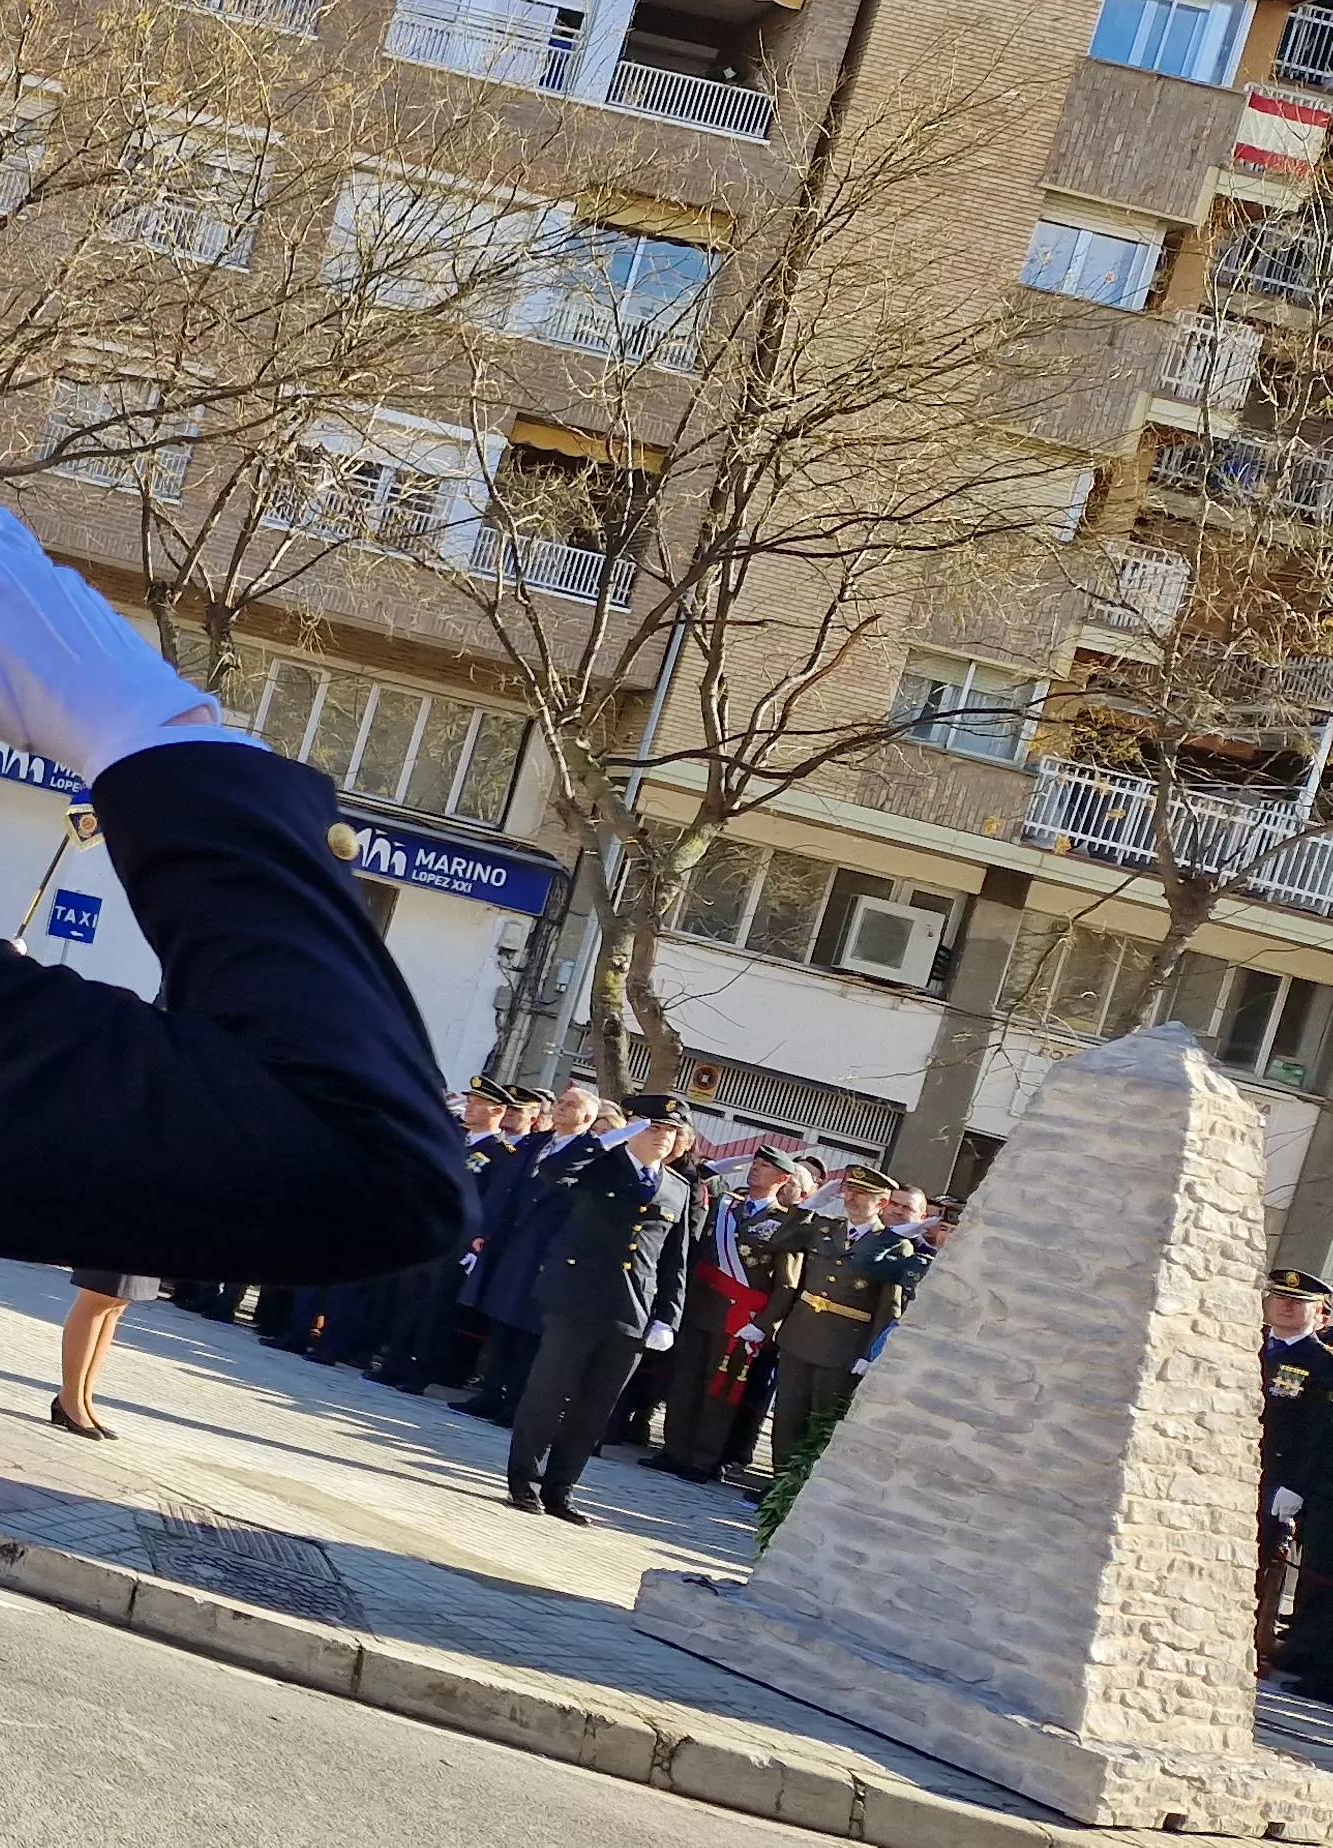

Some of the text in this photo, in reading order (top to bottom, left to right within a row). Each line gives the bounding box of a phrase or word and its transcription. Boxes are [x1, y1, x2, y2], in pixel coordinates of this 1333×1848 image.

[50, 776, 83, 793] LOPE
[415, 848, 507, 887] MARINO
[412, 869, 472, 893] LOPEZ XXI
[54, 905, 98, 928] TAXI
